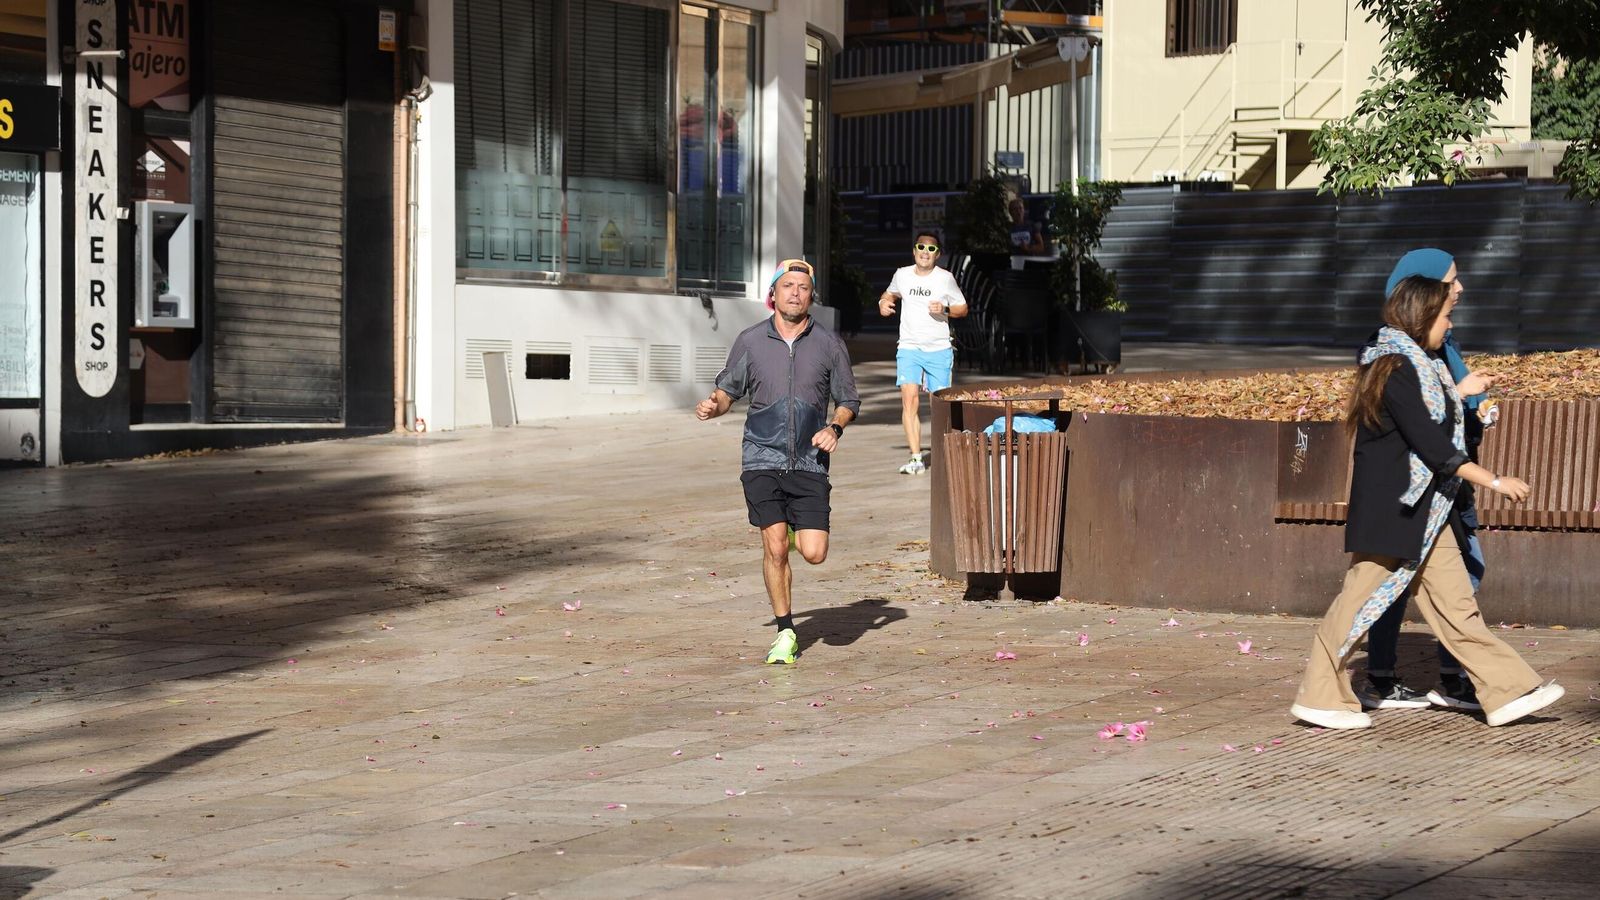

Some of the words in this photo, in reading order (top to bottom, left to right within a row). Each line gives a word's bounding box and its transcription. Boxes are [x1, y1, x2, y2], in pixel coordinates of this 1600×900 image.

[129, 0, 184, 39] ATM
[129, 43, 186, 79] ajero
[0, 98, 15, 139] S
[87, 19, 106, 350] SNEAKERS
[85, 361, 109, 371] SHOP
